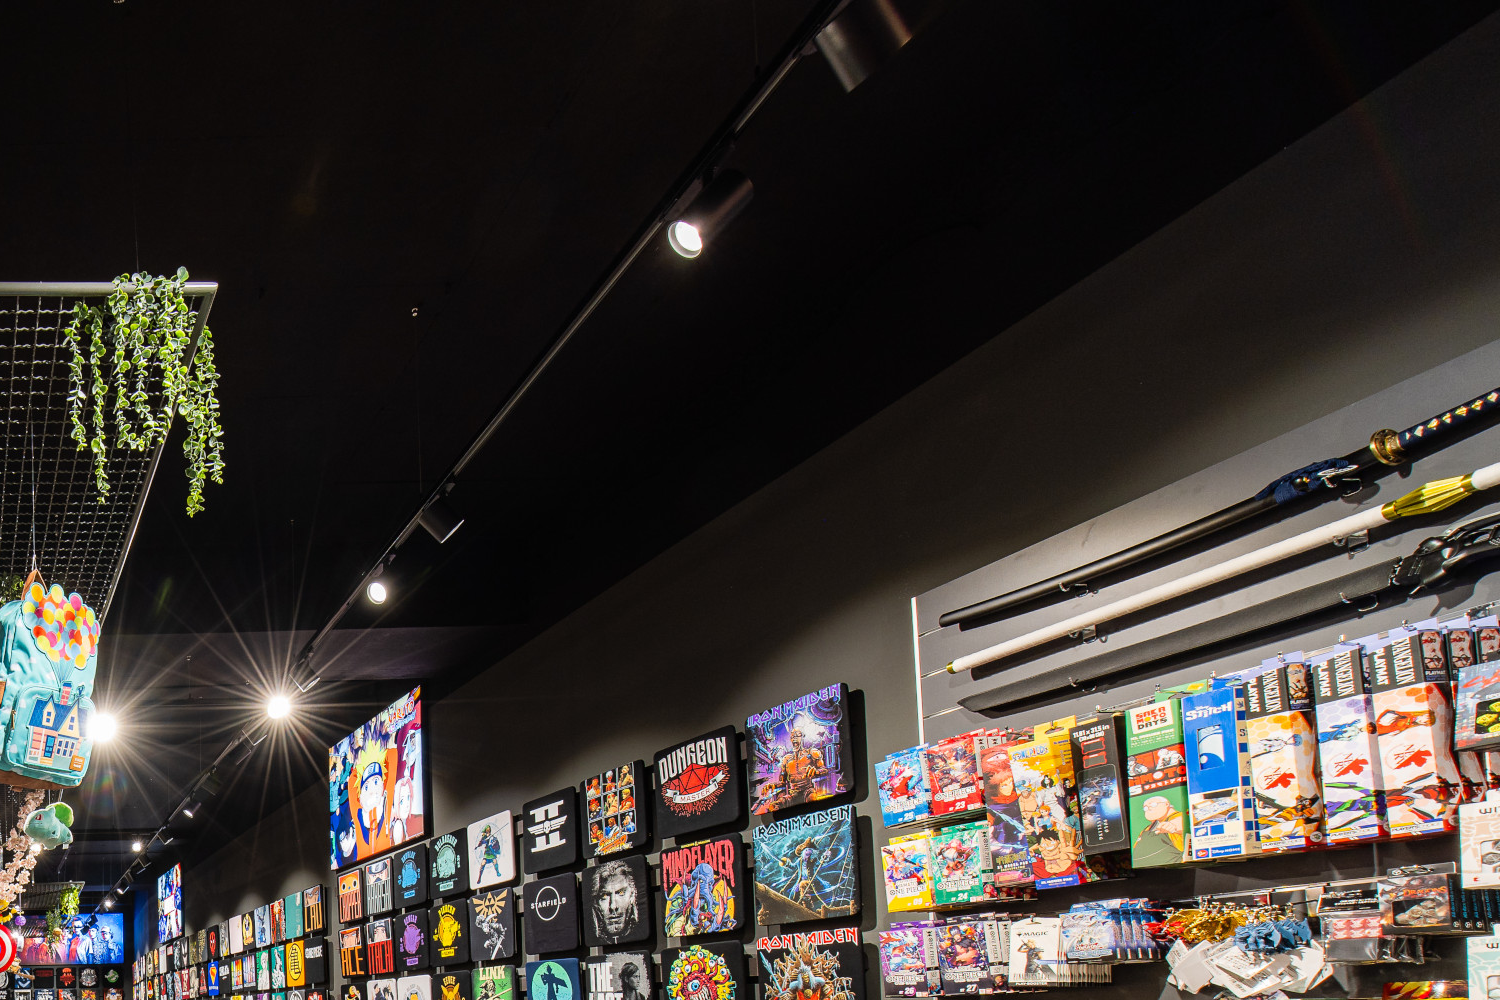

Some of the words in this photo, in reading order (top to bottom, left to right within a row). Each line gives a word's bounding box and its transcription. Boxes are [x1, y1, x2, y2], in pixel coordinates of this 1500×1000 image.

[1317, 661, 1331, 697] PLAYMAT
[1373, 647, 1390, 685] PLAYMAT
[748, 705, 781, 728] IRON
[783, 682, 842, 714] MAIDEN
[1247, 677, 1260, 712] PLAYMAT
[1135, 706, 1166, 719] SAKA
[1138, 718, 1168, 732] DAYS
[1185, 701, 1233, 721] STITCH
[658, 737, 728, 784] DUNGEON
[680, 787, 711, 802] MASTER
[753, 819, 787, 838] IRON
[787, 805, 852, 831] MAIDEN
[904, 813, 914, 821] 25
[662, 839, 736, 892] MINDFLAYER
[530, 897, 567, 909] STARFIELD
[1403, 886, 1448, 897] DRAGONS
[341, 946, 365, 977] ACE
[368, 939, 394, 975] ITACHI
[479, 966, 506, 980] LINK
[588, 962, 613, 992] THE
[966, 984, 977, 992] 27
